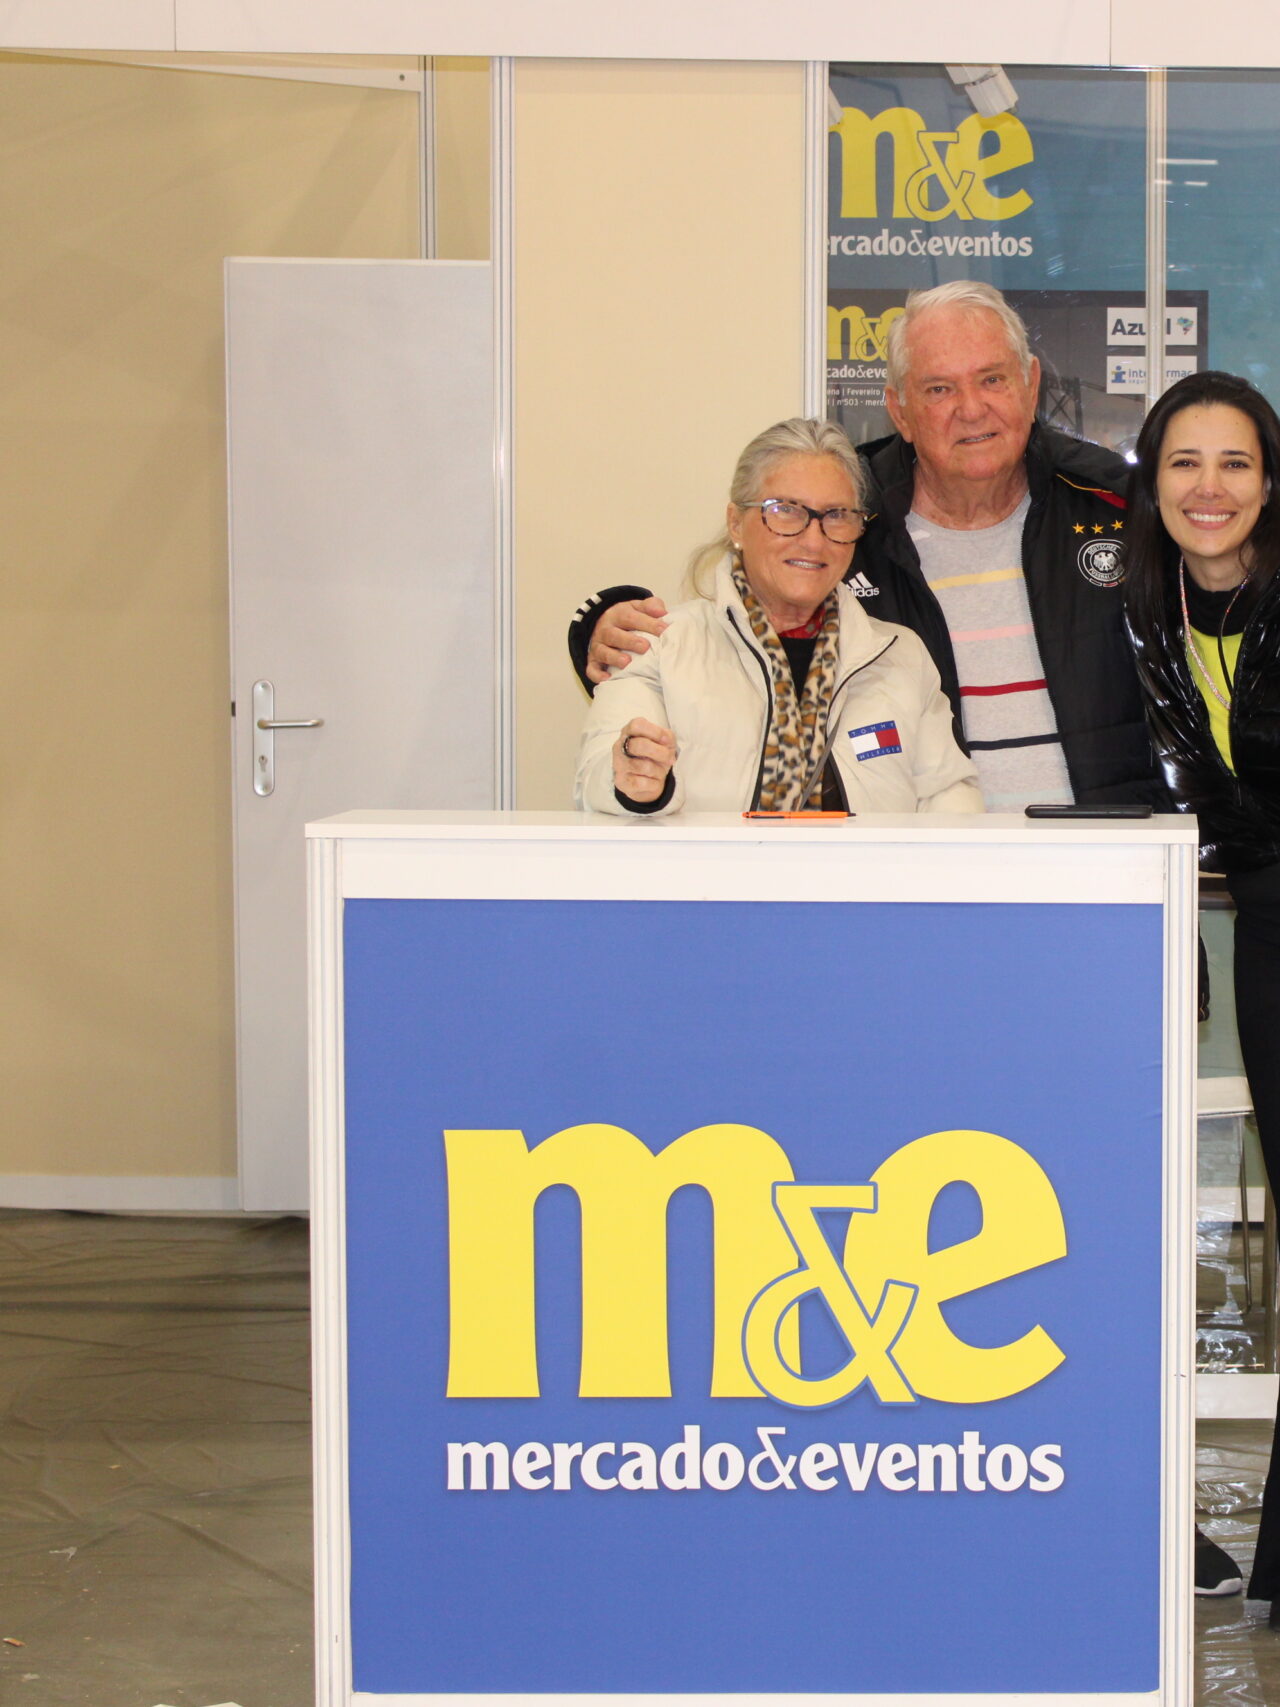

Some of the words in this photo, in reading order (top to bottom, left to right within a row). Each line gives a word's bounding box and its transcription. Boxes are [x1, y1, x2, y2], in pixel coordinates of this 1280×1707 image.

[826, 229, 1034, 257] rcado&eventos
[847, 387, 881, 395] Fevereiro
[850, 587, 880, 598] idas
[443, 1122, 1067, 1410] m&e
[446, 1424, 1066, 1492] mercado&eventos
